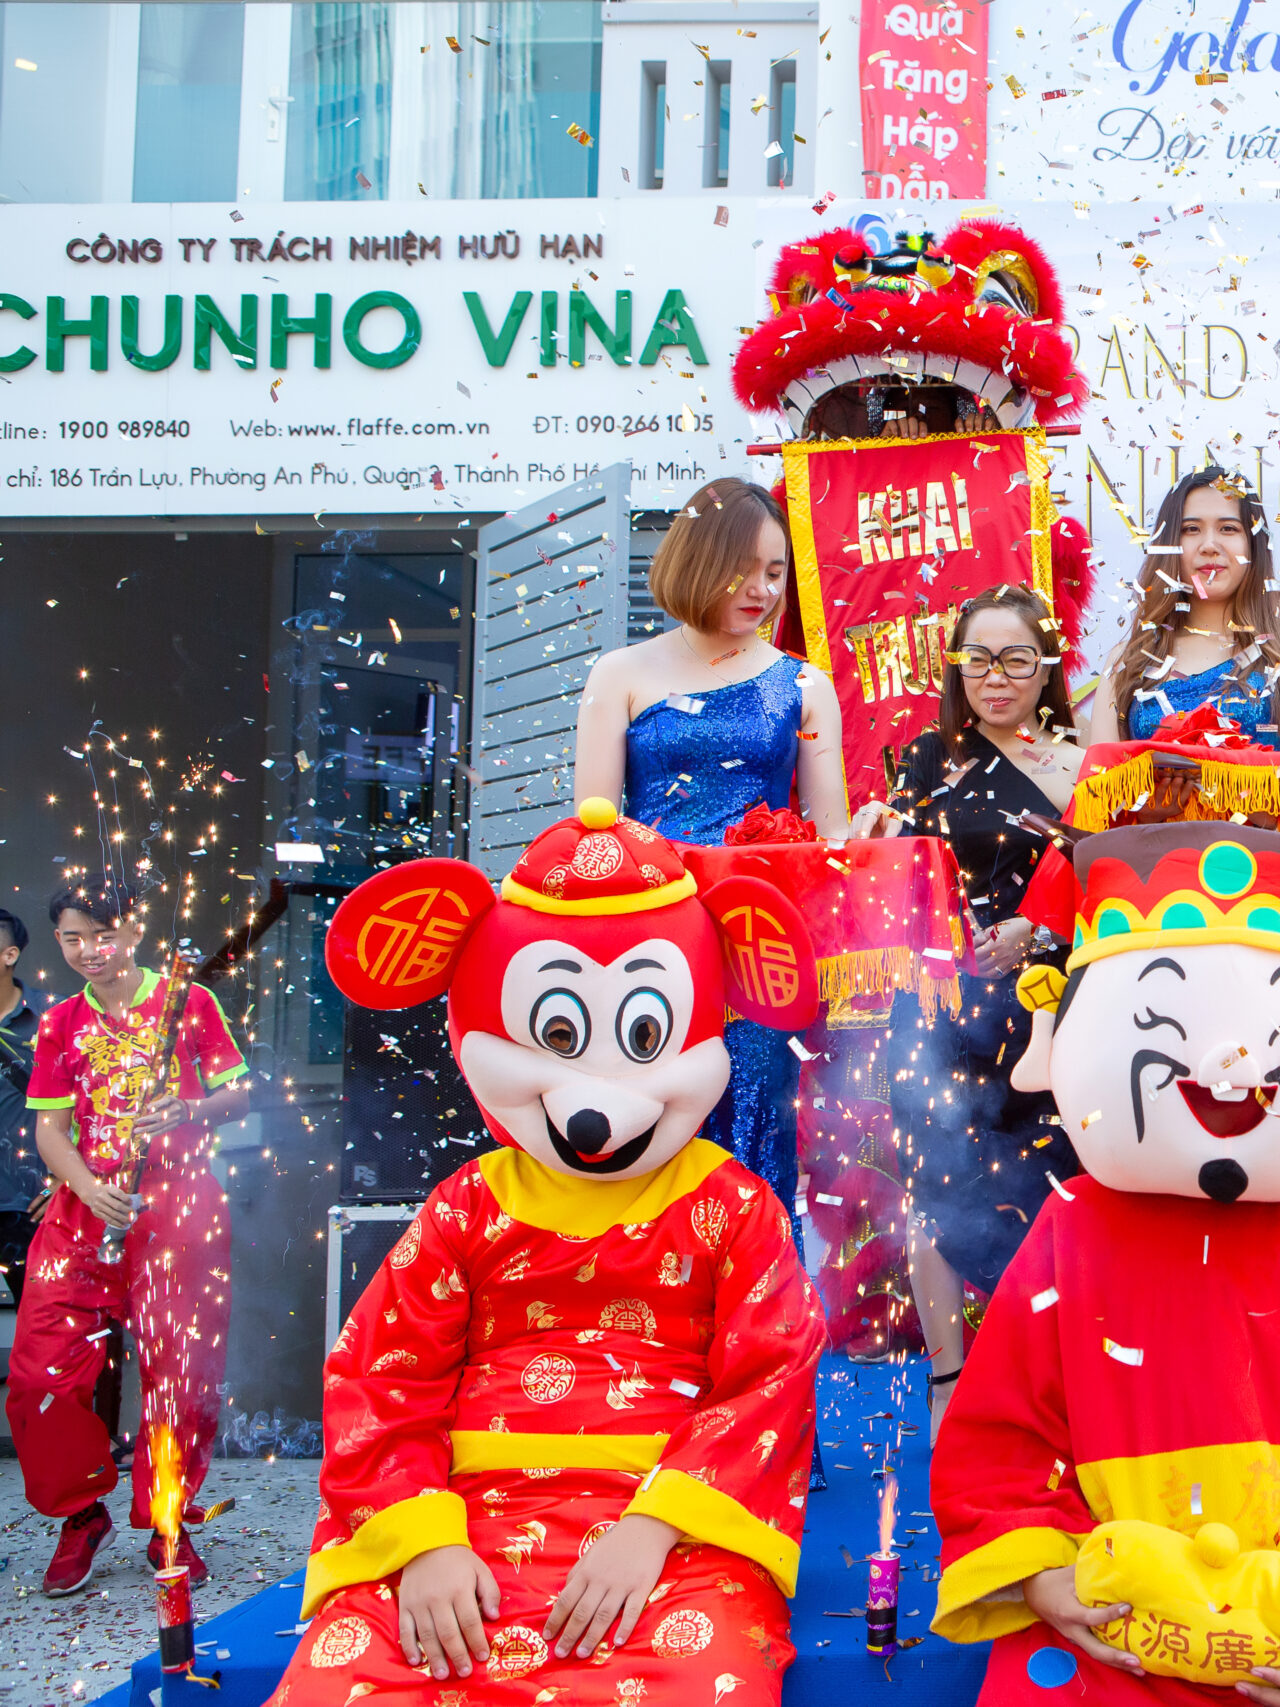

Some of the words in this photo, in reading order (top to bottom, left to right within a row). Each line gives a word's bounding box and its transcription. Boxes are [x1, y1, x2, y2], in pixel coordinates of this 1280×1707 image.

[880, 59, 968, 104] Tặng
[883, 112, 959, 160] Hấp
[66, 232, 163, 264] CÔNG
[178, 238, 217, 263] TY
[230, 230, 333, 262] TRÁCH
[349, 230, 442, 266] NHIỆM
[541, 234, 603, 264] HẠN
[462, 288, 709, 367] VINA
[59, 421, 108, 439] 1900
[118, 420, 190, 438] 989840
[230, 419, 283, 437] Web:
[532, 415, 569, 434] ĐT:
[576, 415, 615, 433] 090
[622, 415, 660, 433] 266
[6, 465, 42, 487] chỉ:
[50, 468, 83, 487] 186
[89, 466, 132, 487] Trần
[190, 466, 266, 491] Phường
[274, 467, 302, 484] An
[454, 464, 519, 483] Thành
[528, 462, 566, 482] Phố
[630, 461, 648, 481] hí
[657, 461, 706, 481] Minh
[857, 476, 974, 566] KHAI
[844, 603, 960, 704] TRƯƠ
[354, 1165, 377, 1187] PS
